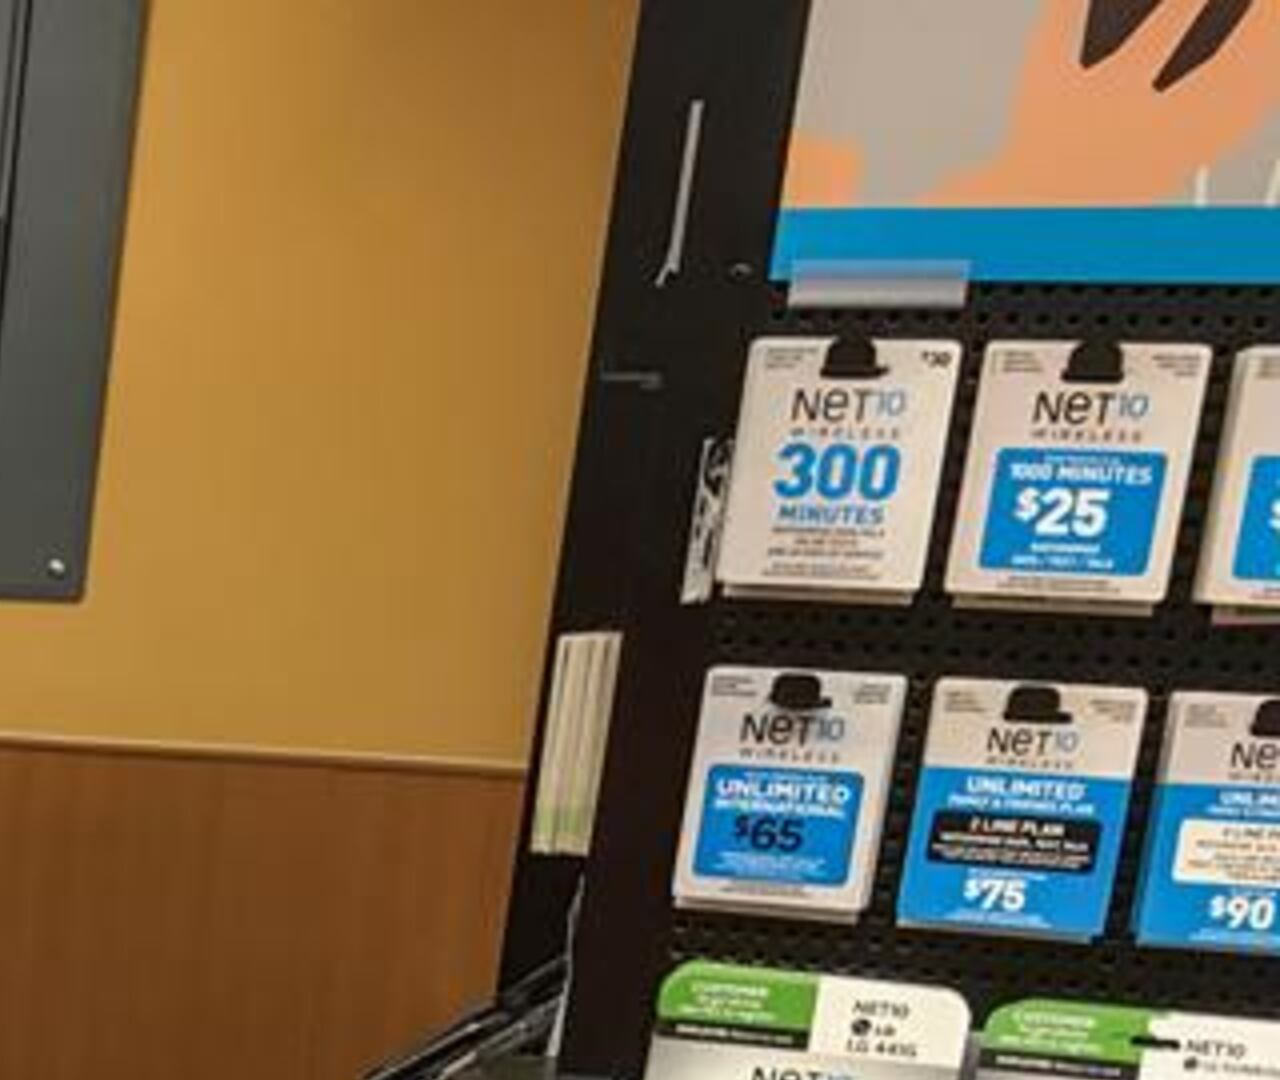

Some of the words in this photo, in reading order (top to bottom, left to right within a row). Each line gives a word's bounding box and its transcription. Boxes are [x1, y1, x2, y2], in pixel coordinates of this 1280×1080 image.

[772, 442, 902, 501] 300
[1008, 461, 1053, 482] 1000
[1057, 463, 1153, 486] MINUTES
[776, 504, 886, 525] MINUTES
[1013, 486, 1112, 538] $25
[715, 778, 852, 804] UNLIMITED
[966, 775, 1087, 801] UNLIMITED
[734, 814, 805, 852] $65
[963, 878, 1026, 912] $75
[1209, 895, 1276, 929] $90
